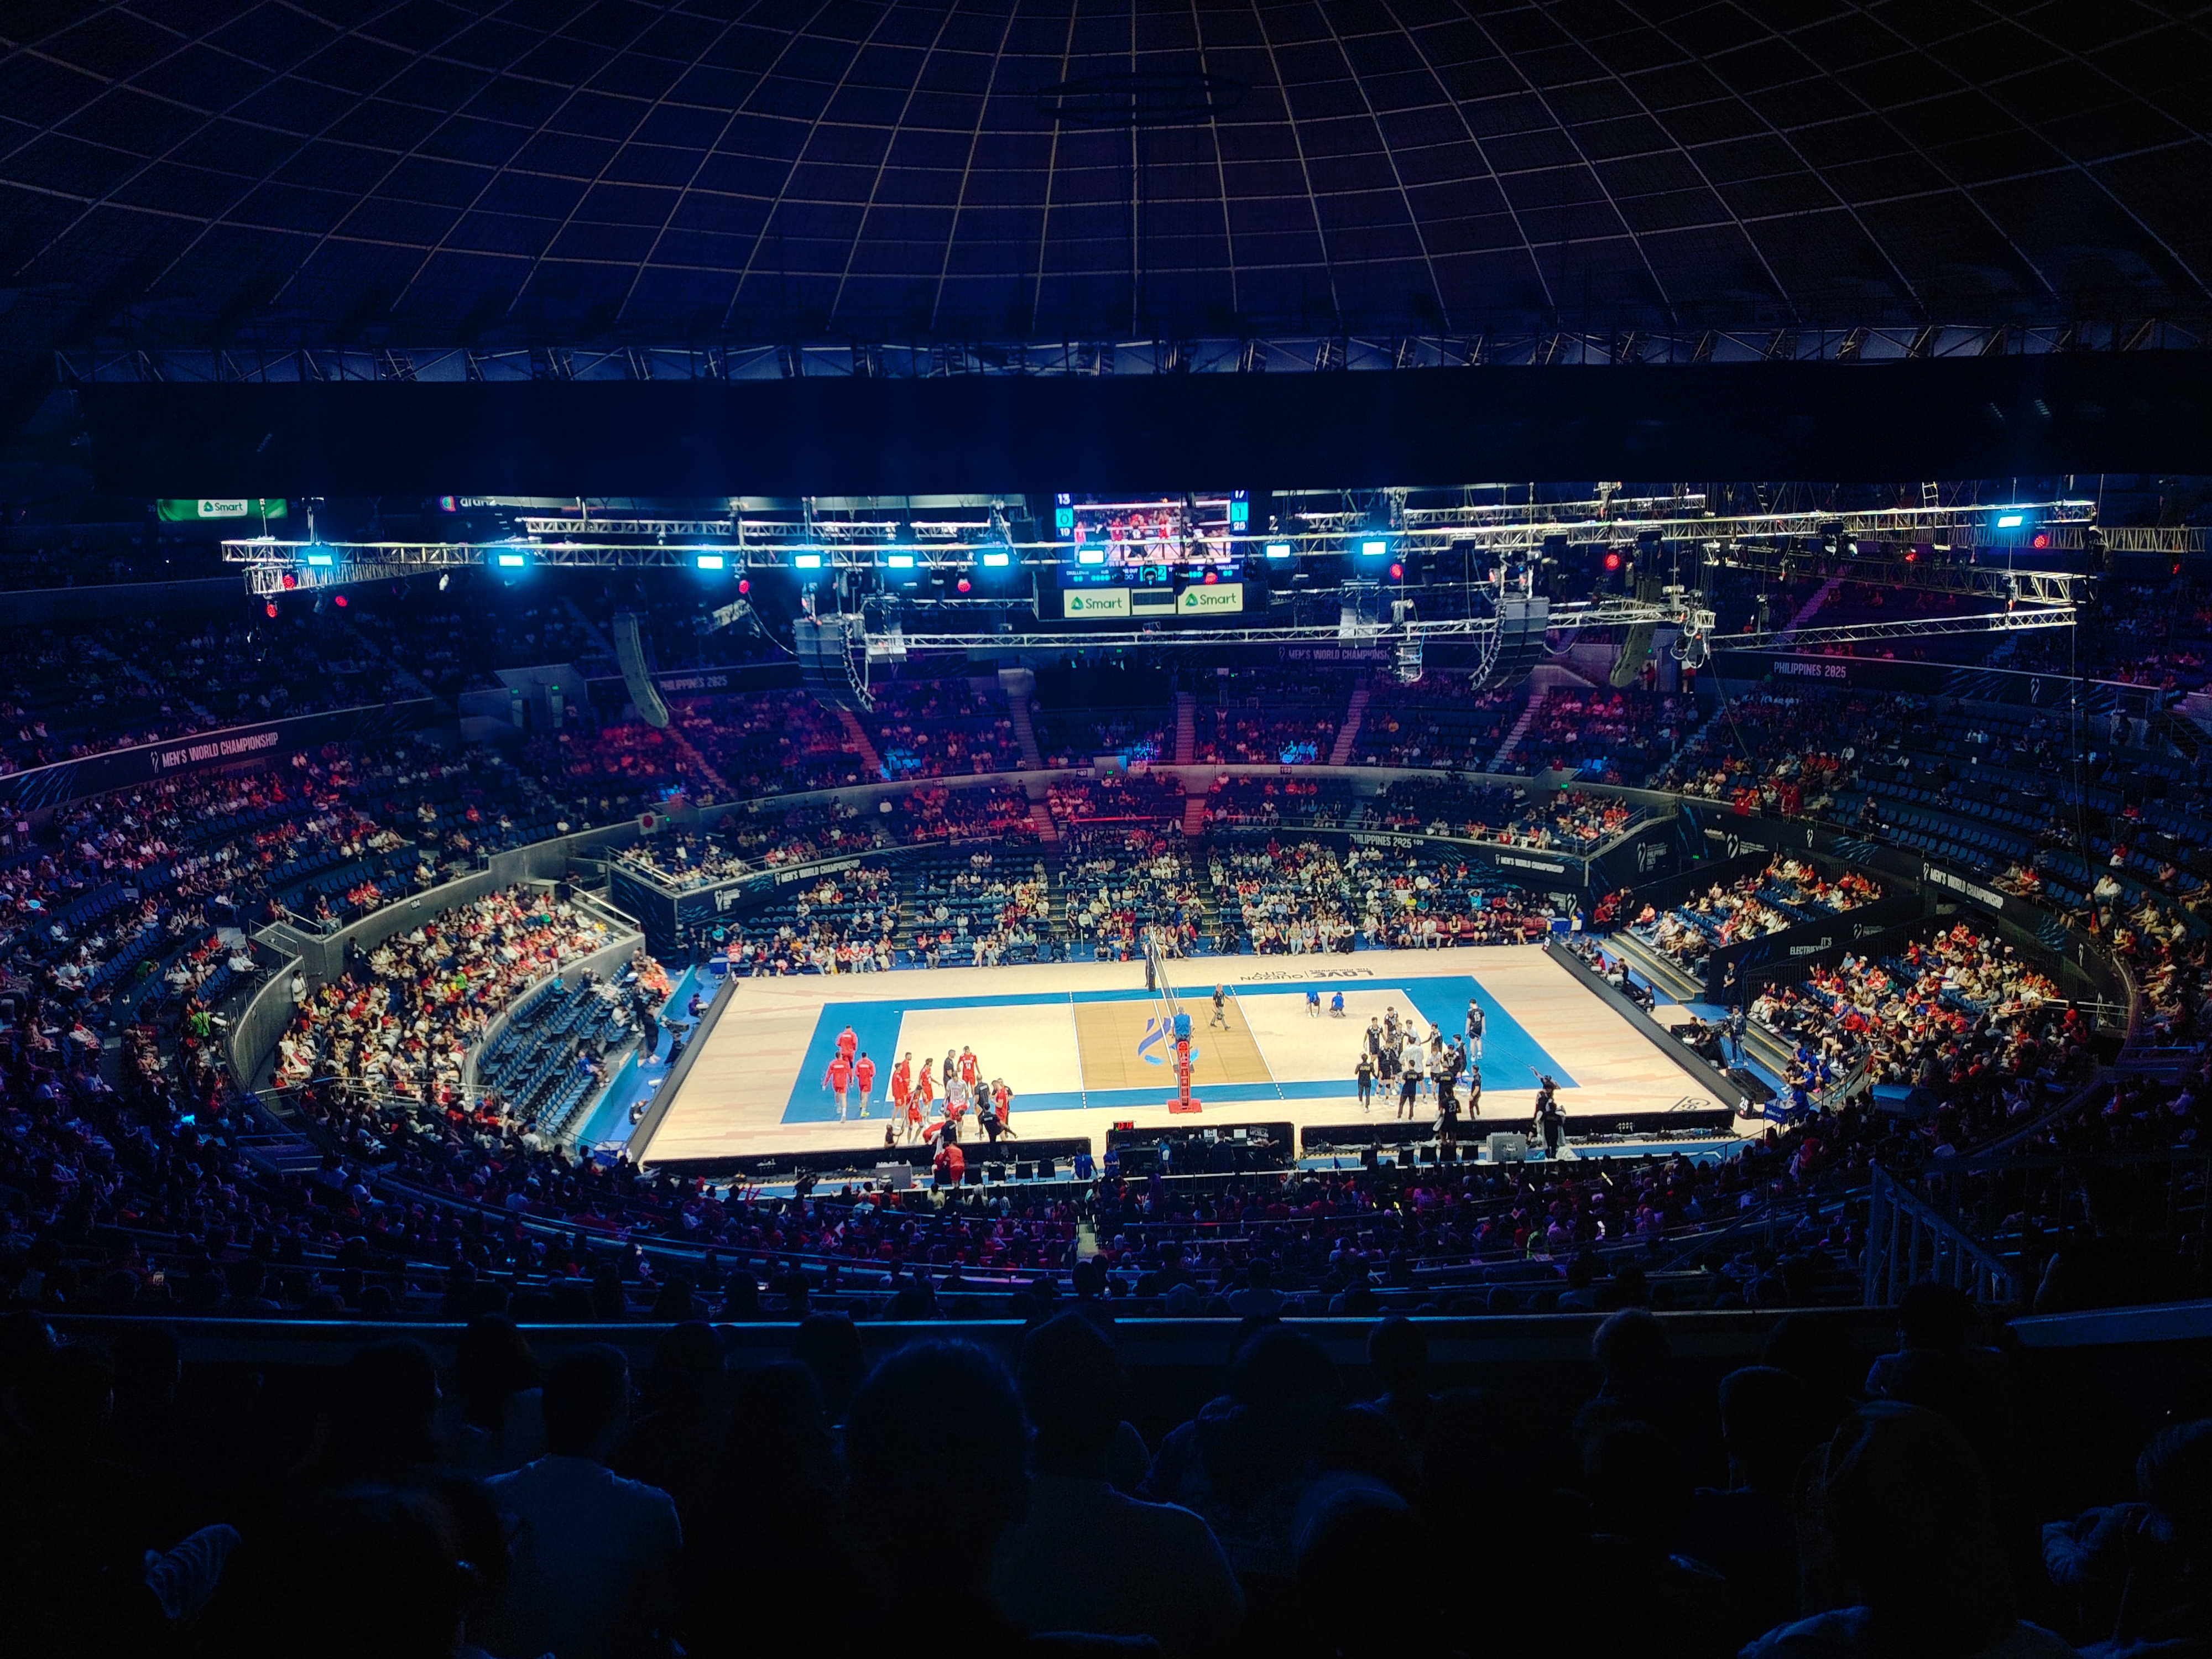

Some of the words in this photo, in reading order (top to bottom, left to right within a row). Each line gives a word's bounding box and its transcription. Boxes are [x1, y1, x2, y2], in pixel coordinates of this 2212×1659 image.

[215, 502, 243, 512] Smart
[1085, 597, 1123, 609] Smart
[1199, 592, 1237, 605] Smart
[1313, 649, 1340, 660] WORLD
[1773, 661, 1821, 676] PHILIPPINES
[1824, 665, 1846, 679] 2025
[162, 749, 187, 768] MEN'S
[189, 743, 218, 761] WORLD
[220, 732, 278, 755] CHAMPIONSHIP
[1350, 833, 1391, 847] PHILIPPINES
[1393, 837, 1412, 849] 2025
[781, 870, 799, 883] MEN'S
[799, 866, 819, 879] WORLD
[820, 859, 860, 875] CHAMPIONSHIP
[1930, 868, 1946, 885] MEN'S
[1948, 874, 1966, 893] WORLD
[1966, 883, 2004, 910] CHAMPIONSHIP
[1820, 937, 1832, 946] IT'S
[1311, 970, 1374, 978] LOVE
[1739, 1096, 1749, 1112] 25
